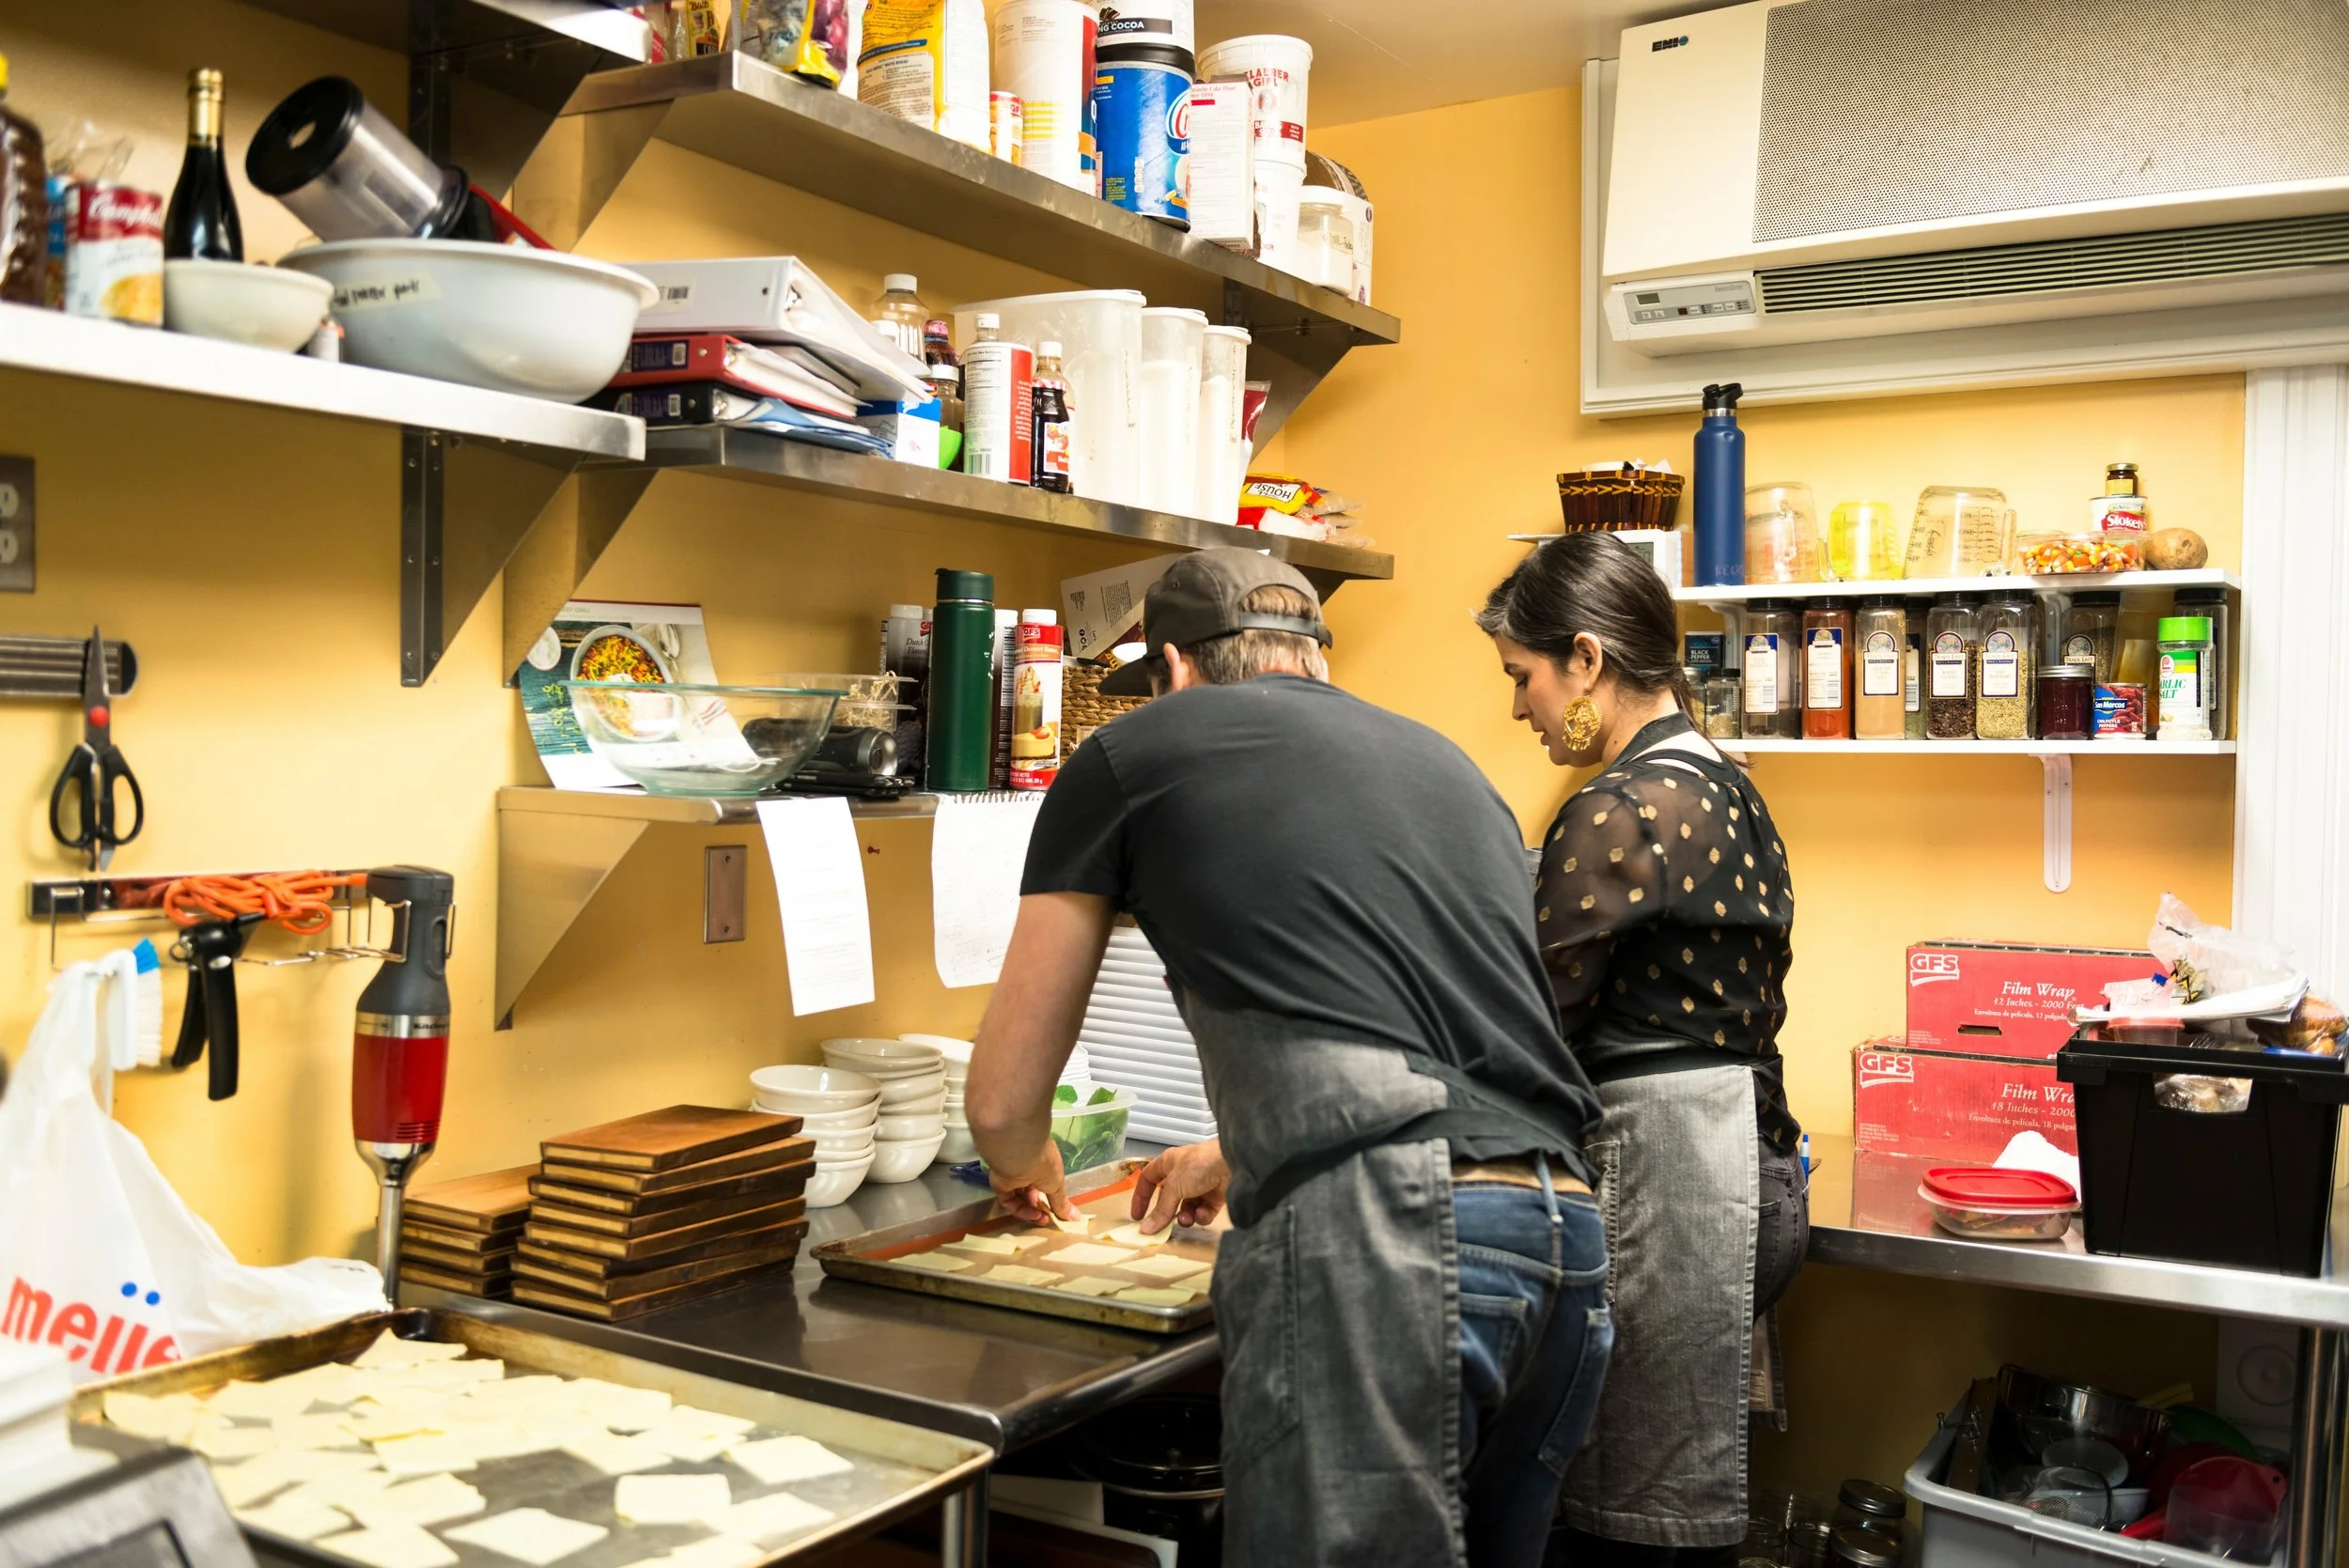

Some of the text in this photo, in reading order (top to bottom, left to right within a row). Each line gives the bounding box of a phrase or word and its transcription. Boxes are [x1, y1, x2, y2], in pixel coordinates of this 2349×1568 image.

[1111, 21, 1145, 31] COCOA
[1909, 953, 1959, 971] GFS
[2001, 981, 2076, 1001] Film Wrap
[1994, 997, 2004, 1006] 12
[2006, 998, 2033, 1008] Inches
[2041, 1000, 2064, 1009] 2000
[1973, 1008, 2002, 1017] Envoltura
[2002, 1009, 2010, 1017] de
[1859, 1052, 1912, 1074] GFS
[2000, 1082, 2038, 1101] Film
[1991, 1101, 2004, 1111] 18
[2006, 1102, 2039, 1115] Inches
[1968, 1112, 2001, 1124] Envoltura
[2002, 1116, 2012, 1125] de
[2043, 1120, 2052, 1128] 18
